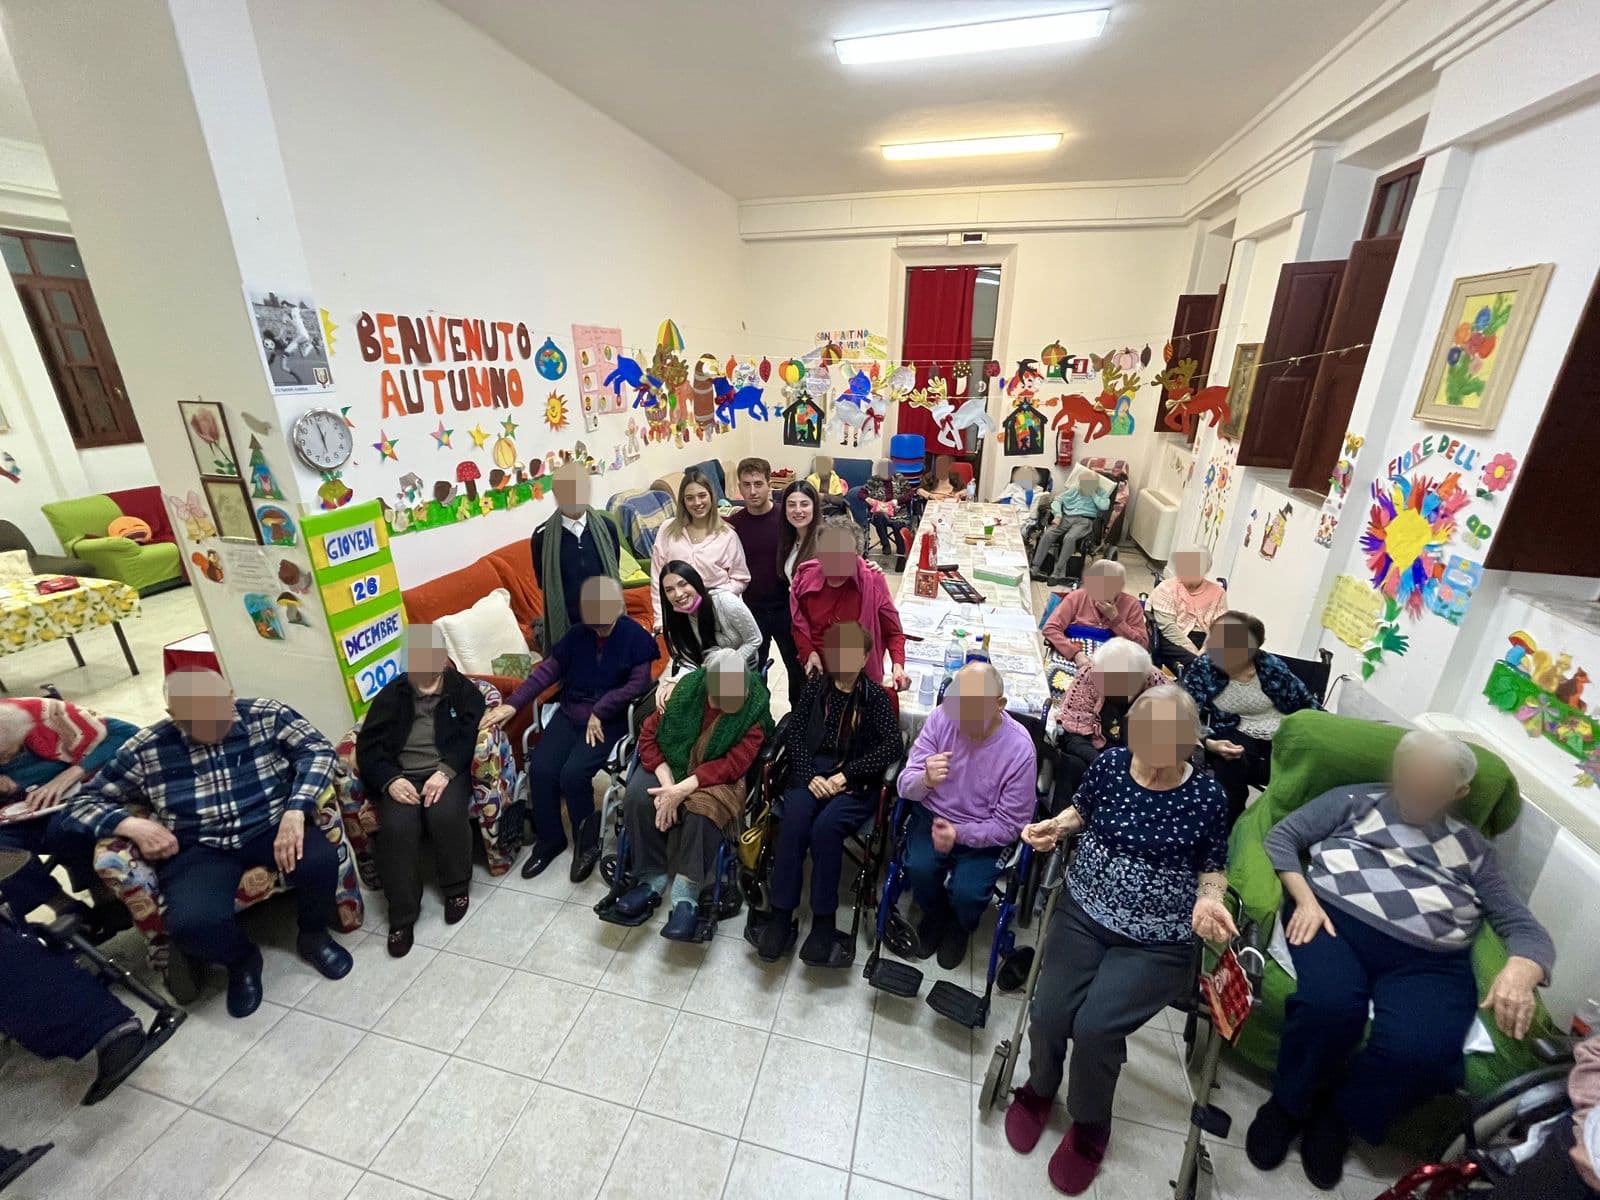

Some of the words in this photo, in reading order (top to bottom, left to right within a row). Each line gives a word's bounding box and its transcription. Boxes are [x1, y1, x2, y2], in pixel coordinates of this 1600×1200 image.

[356, 311, 532, 365] BENVENUTO
[381, 366, 524, 419] AUTUNNO
[1388, 435, 1434, 477] FIORE
[326, 527, 375, 560] GIOVEDI
[353, 576, 379, 601] 26
[345, 612, 400, 658] DICEMBRE
[361, 658, 402, 697] 202
